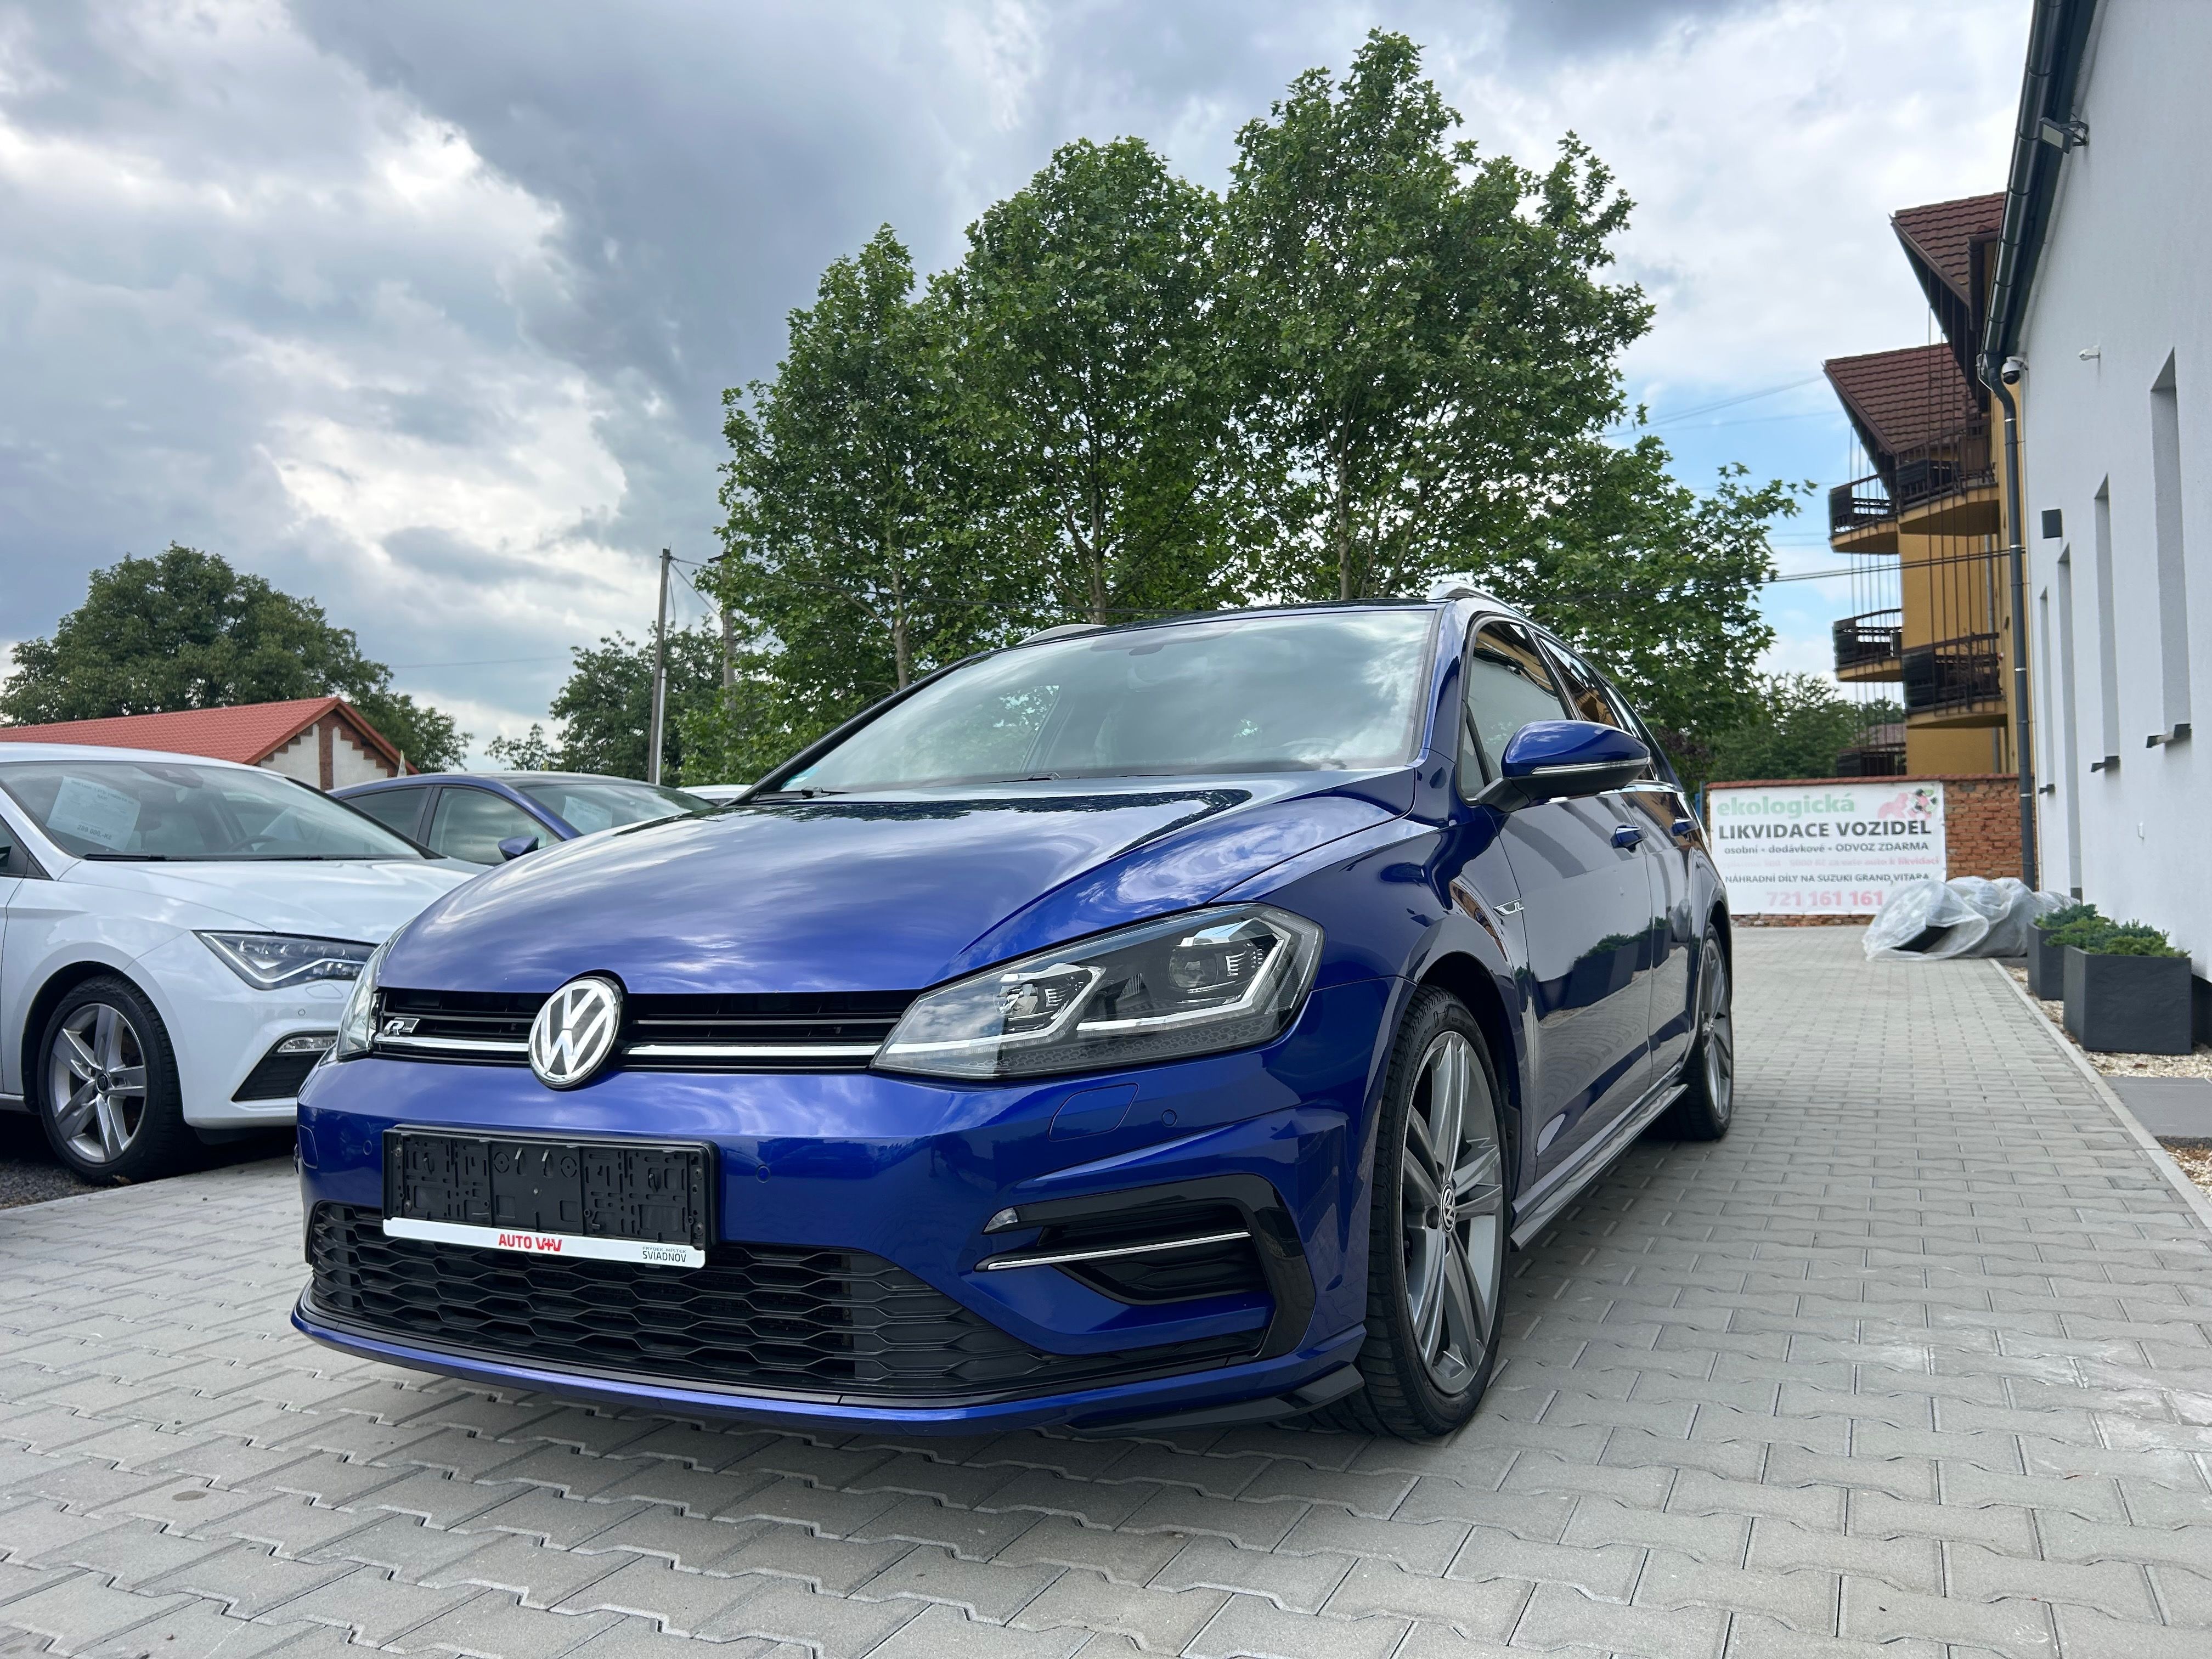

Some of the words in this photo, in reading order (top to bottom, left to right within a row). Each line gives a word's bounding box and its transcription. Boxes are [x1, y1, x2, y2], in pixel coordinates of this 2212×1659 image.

[1717, 793, 1855, 819] ekologická
[1719, 823, 1830, 839] LIKVIDACE
[1836, 820, 1932, 837] VOZIDEL
[1724, 845, 1758, 854] osobní
[1768, 844, 1825, 854] dodávkové
[1836, 843, 1876, 853] ODVOZ
[1877, 842, 1929, 852] ZDARMA
[1725, 873, 1776, 883] NÁHRADNÍ
[1778, 872, 1798, 883] DÍLY
[1801, 874, 1815, 883] NA
[1817, 873, 1853, 882] SUZUKI
[1855, 873, 1891, 882] GRAND
[1767, 891, 1802, 907] 721
[1808, 890, 1842, 906] 161
[1849, 890, 1883, 906] 161
[499, 1233, 532, 1249] AUTO
[642, 1250, 686, 1262] SVIADNOV
